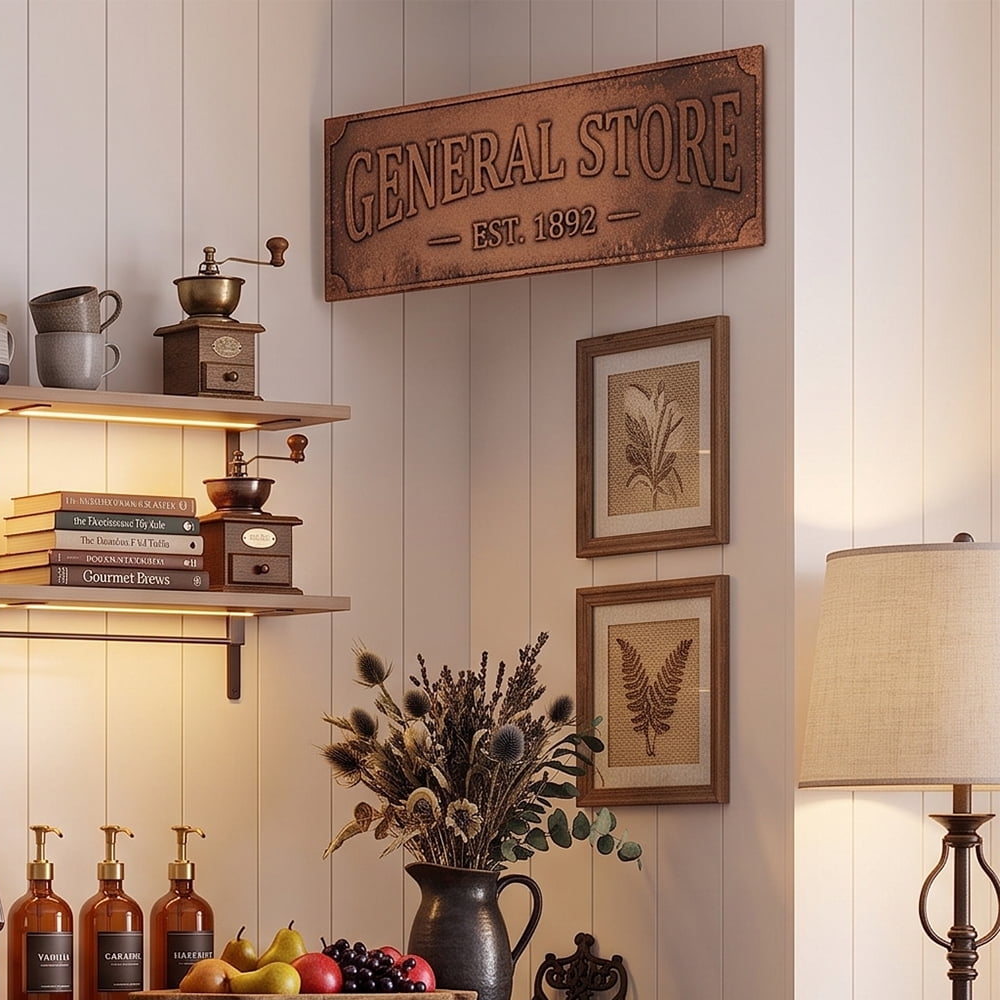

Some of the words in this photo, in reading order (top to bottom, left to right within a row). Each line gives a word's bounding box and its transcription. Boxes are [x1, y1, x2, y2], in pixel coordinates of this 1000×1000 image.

[345, 120, 565, 243] GENERAL
[578, 91, 742, 194] STORE
[472, 218, 526, 250] EST.
[534, 206, 597, 242] 1892
[83, 569, 134, 584] Gourmet
[137, 571, 170, 586] Brews
